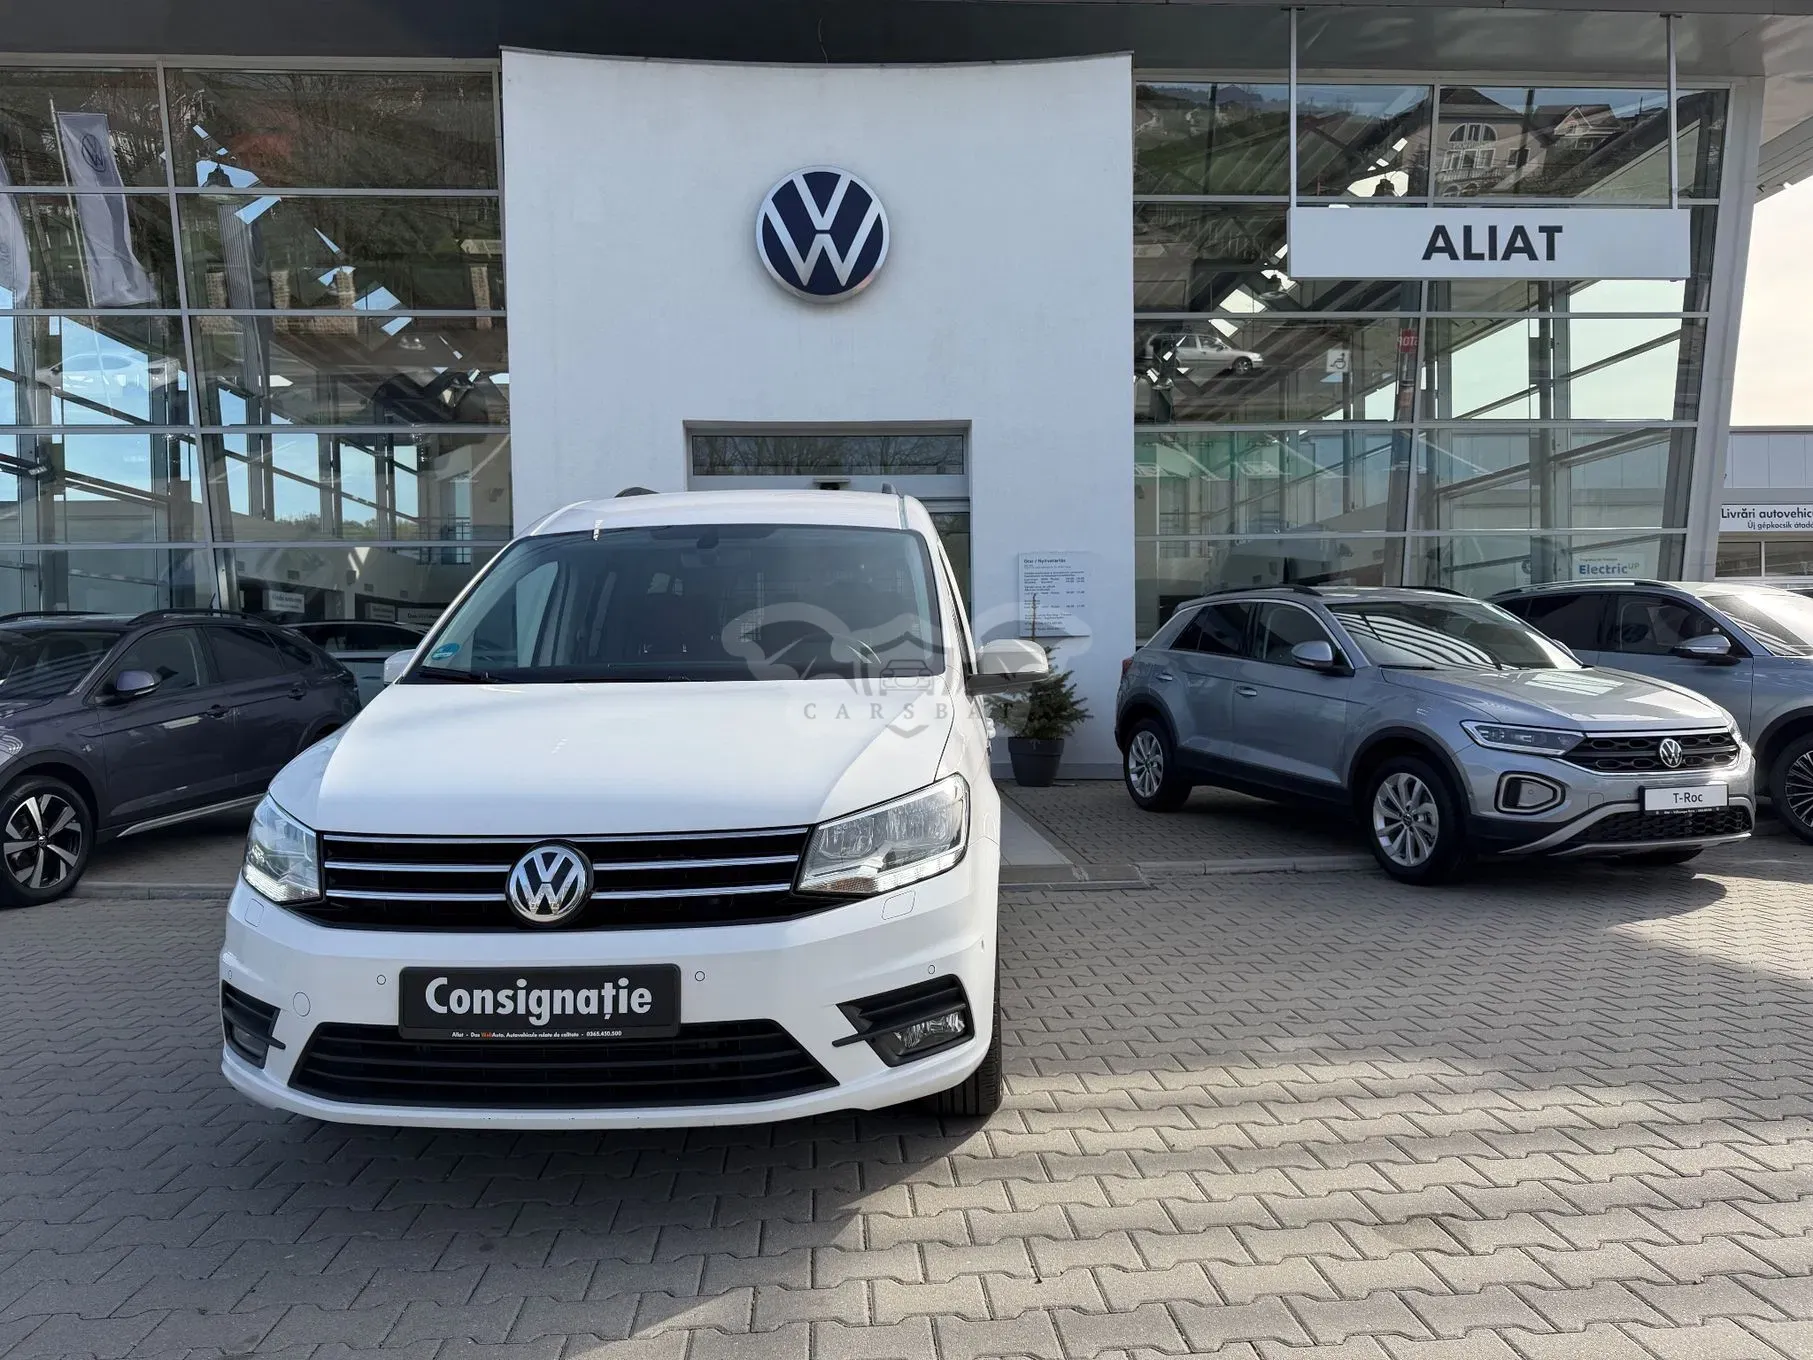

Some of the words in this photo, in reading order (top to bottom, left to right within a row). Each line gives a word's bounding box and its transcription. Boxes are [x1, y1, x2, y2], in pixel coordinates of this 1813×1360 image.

[1422, 225, 1563, 260] ALIAT
[1721, 508, 1755, 518] Livrări
[1759, 507, 1813, 518] autovehic
[1672, 792, 1703, 803] T-Roc
[425, 977, 652, 1026] Consignație
